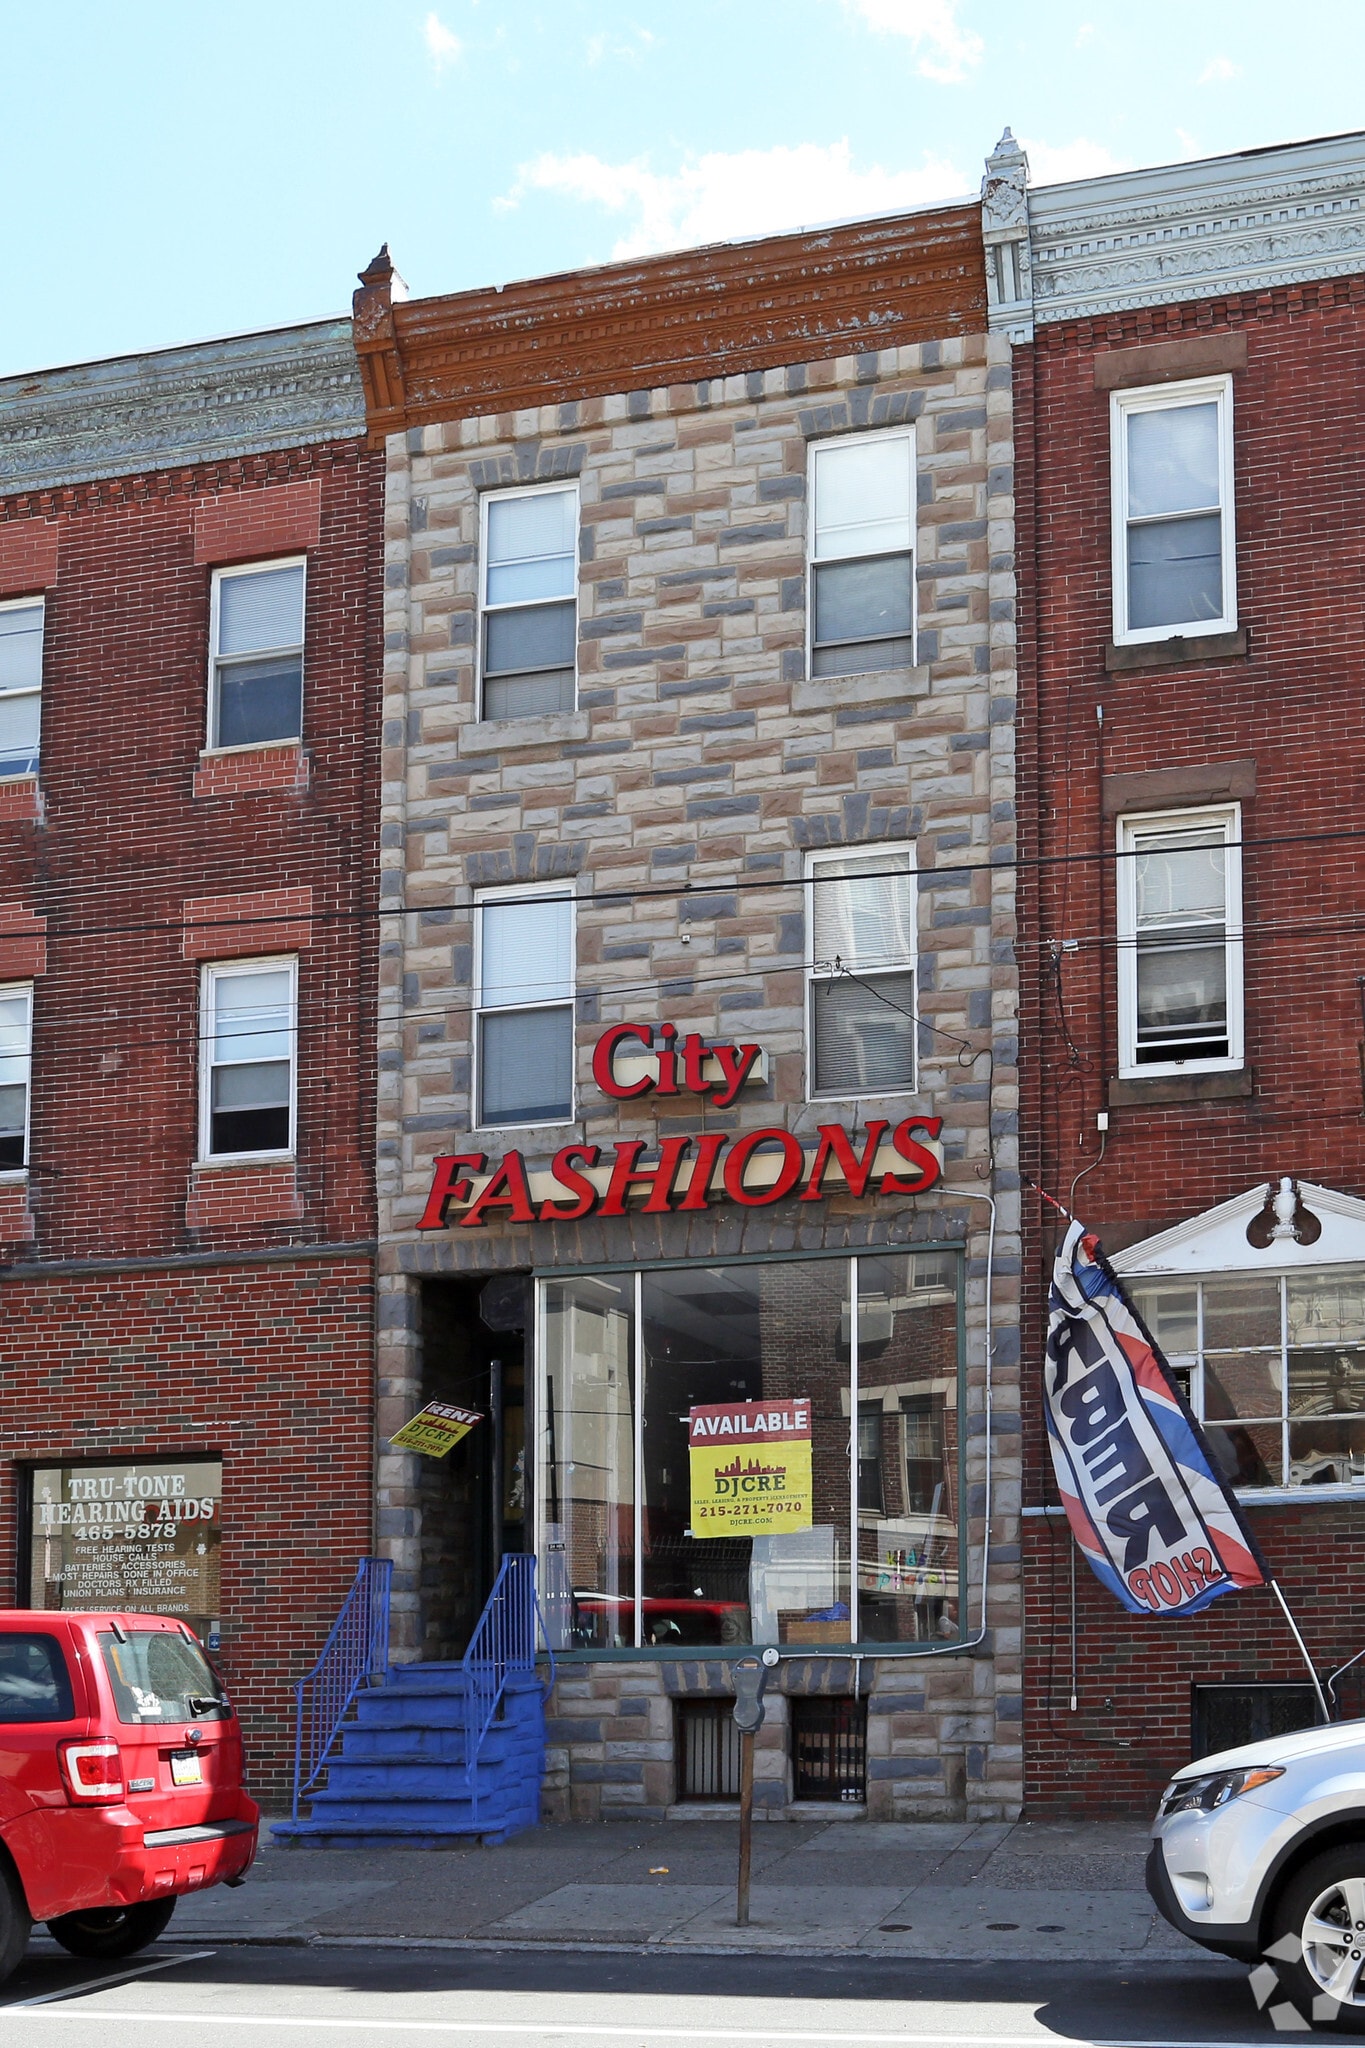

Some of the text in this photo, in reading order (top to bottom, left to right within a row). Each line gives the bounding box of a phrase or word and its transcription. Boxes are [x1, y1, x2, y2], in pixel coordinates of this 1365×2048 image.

[592, 1022, 762, 1108] City
[415, 1115, 944, 1231] FASHIONS
[426, 1406, 480, 1424] RENT
[692, 1411, 807, 1436] AVAILABLE
[408, 1424, 455, 1443] DJCRE
[68, 1474, 186, 1500] TRU-TONE
[714, 1474, 786, 1497] DJCRE
[39, 1497, 215, 1525] HEARING AIDS
[700, 1501, 802, 1517] 215-271-7070
[729, 1517, 773, 1526] DJCRE.COM
[74, 1522, 177, 1541] 465-5878
[75, 1543, 175, 1555] FREE HEARING TESTS
[64, 1561, 186, 1572] BATTERIES ACCESSORIES
[93, 1553, 157, 1563] HOUSE CALLS
[53, 1569, 199, 1581] MOST REPAIRS DONE IN OFFICE
[78, 1578, 172, 1589] DOCTORS RX FILLED
[63, 1586, 187, 1598] UNION PLANS INSURANCE
[125, 1605, 137, 1613] ON
[140, 1604, 154, 1613] ALL
[156, 1603, 190, 1612] BRANDS
